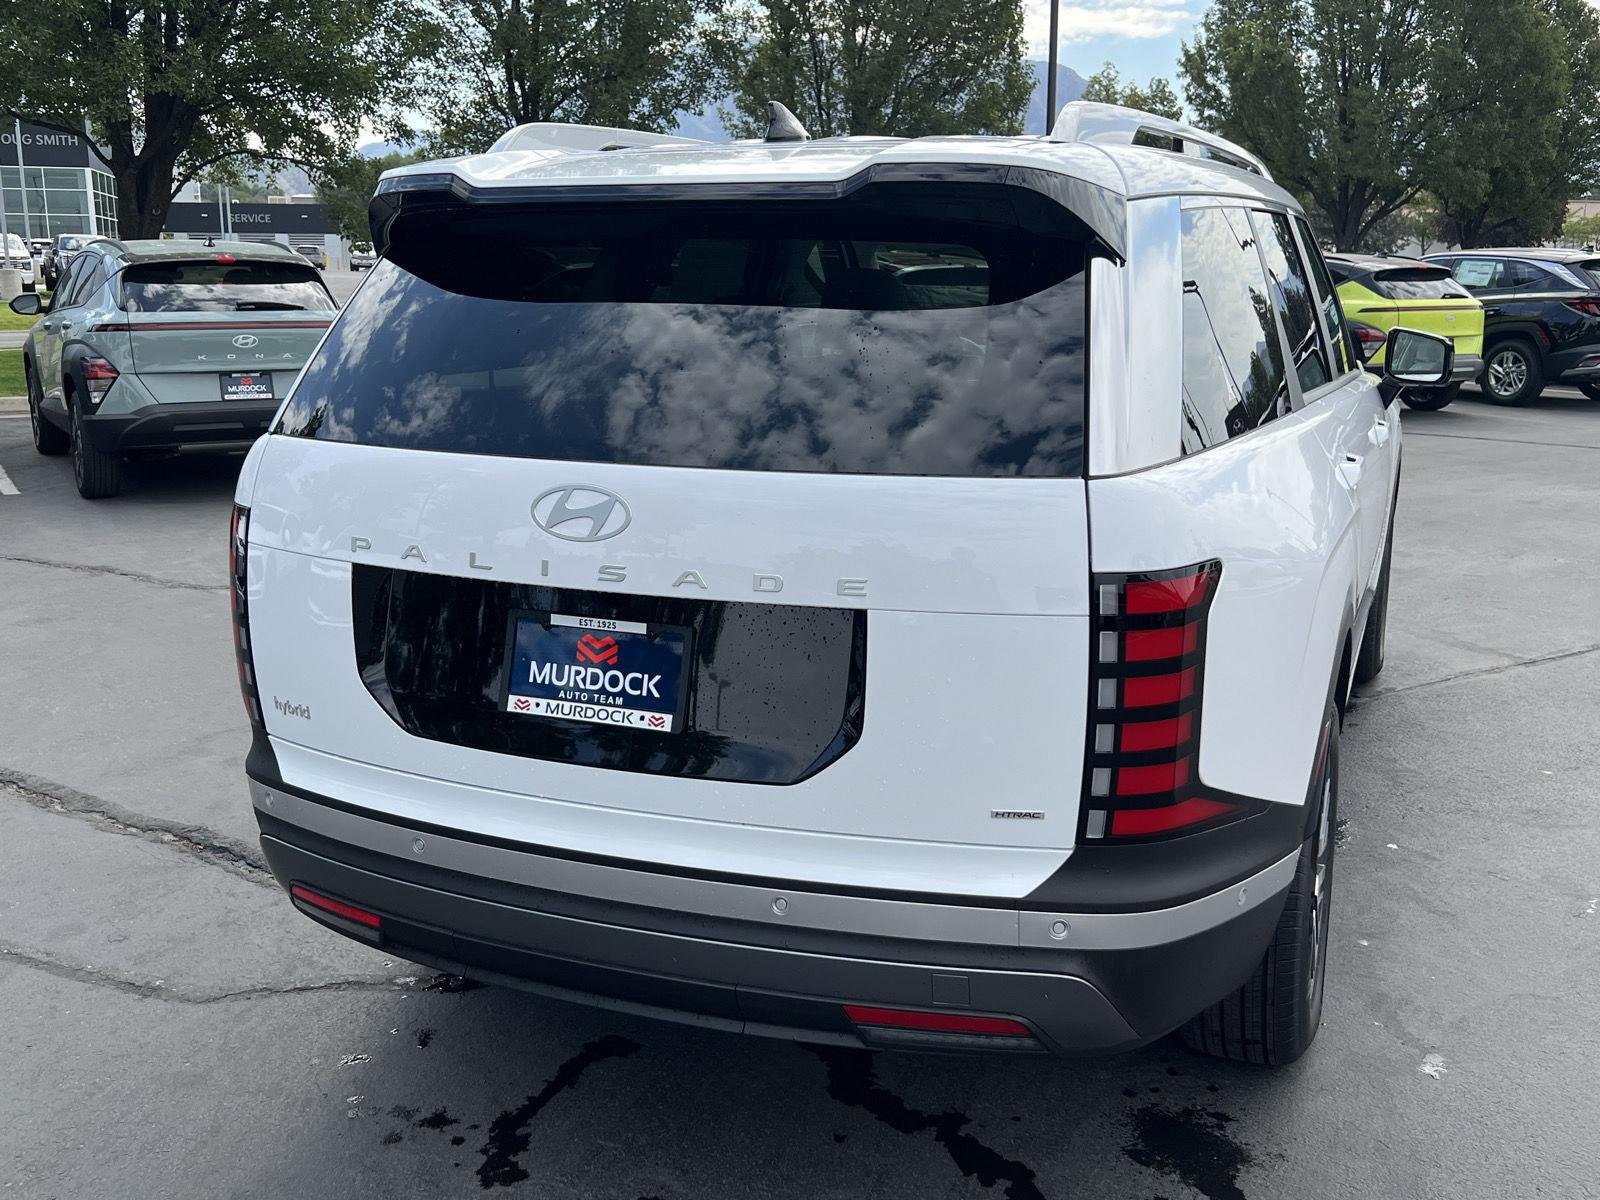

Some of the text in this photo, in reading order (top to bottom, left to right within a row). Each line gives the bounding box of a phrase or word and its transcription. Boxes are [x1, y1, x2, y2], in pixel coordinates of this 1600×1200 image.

[35, 134, 79, 147] SMITH
[229, 213, 271, 223] SERVICE
[198, 352, 293, 360] KONA
[227, 384, 267, 392] MURDOCK
[350, 535, 869, 597] PALISADE
[578, 618, 617, 630] EST. 1925
[528, 660, 662, 698] MURDOCK
[558, 689, 624, 706] AUTO TEAM
[273, 695, 311, 720] hybrid
[545, 701, 634, 725] MURDOCK
[994, 811, 1041, 819] HTRAC
